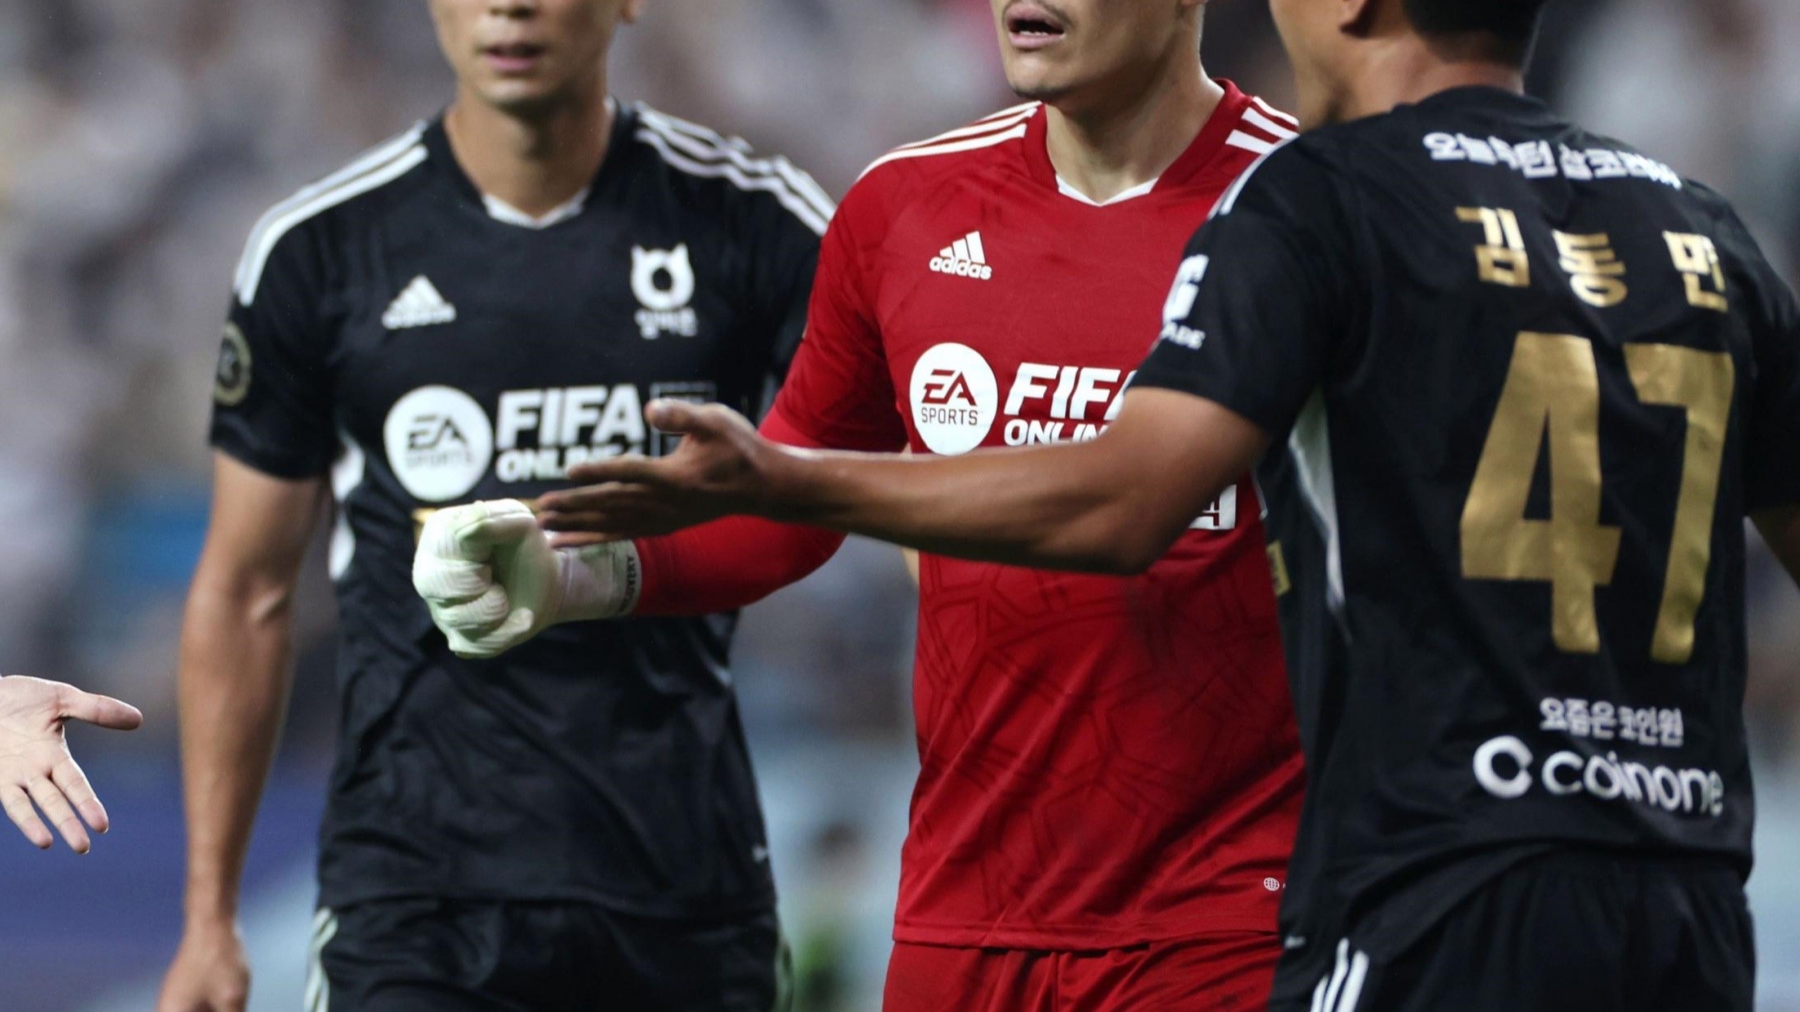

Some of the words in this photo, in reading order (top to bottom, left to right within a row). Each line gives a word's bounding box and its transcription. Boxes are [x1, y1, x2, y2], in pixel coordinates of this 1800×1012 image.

[929, 256, 992, 280] adidas
[922, 368, 977, 407] EA
[408, 414, 468, 450] EA
[496, 384, 647, 450] FIFA
[921, 407, 979, 426] SPORTS
[1003, 419, 1109, 446] ONLIN
[1460, 331, 1735, 664] 47
[1540, 697, 1617, 739] 요즘은
[1542, 750, 1724, 816] coinone
